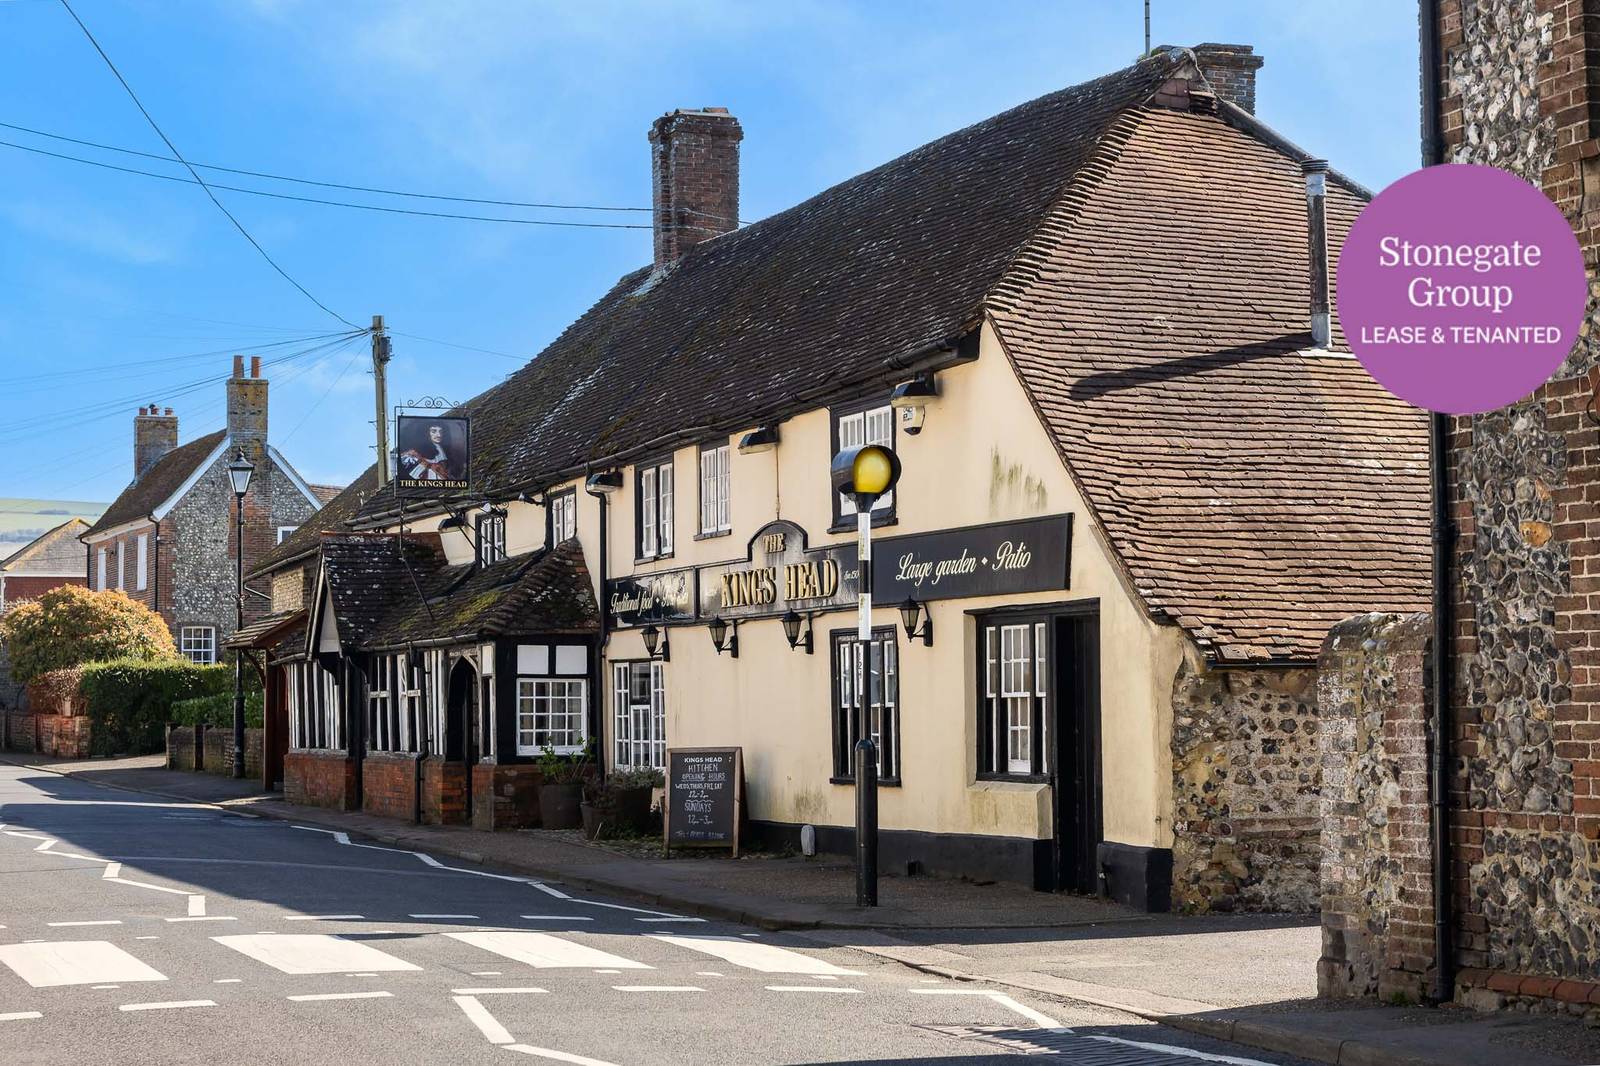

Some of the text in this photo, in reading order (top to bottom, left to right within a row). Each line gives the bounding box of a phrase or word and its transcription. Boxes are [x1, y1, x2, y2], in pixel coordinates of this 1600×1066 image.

[418, 480, 444, 488] KINGS
[445, 480, 467, 488] HEAD
[763, 533, 786, 553] THE
[896, 541, 1032, 587] Large garden Patio
[720, 566, 777, 608] KINGS
[784, 558, 838, 601] HEAD
[688, 763, 718, 773] KITCHEN
[684, 802, 712, 813] SUNDAYS
